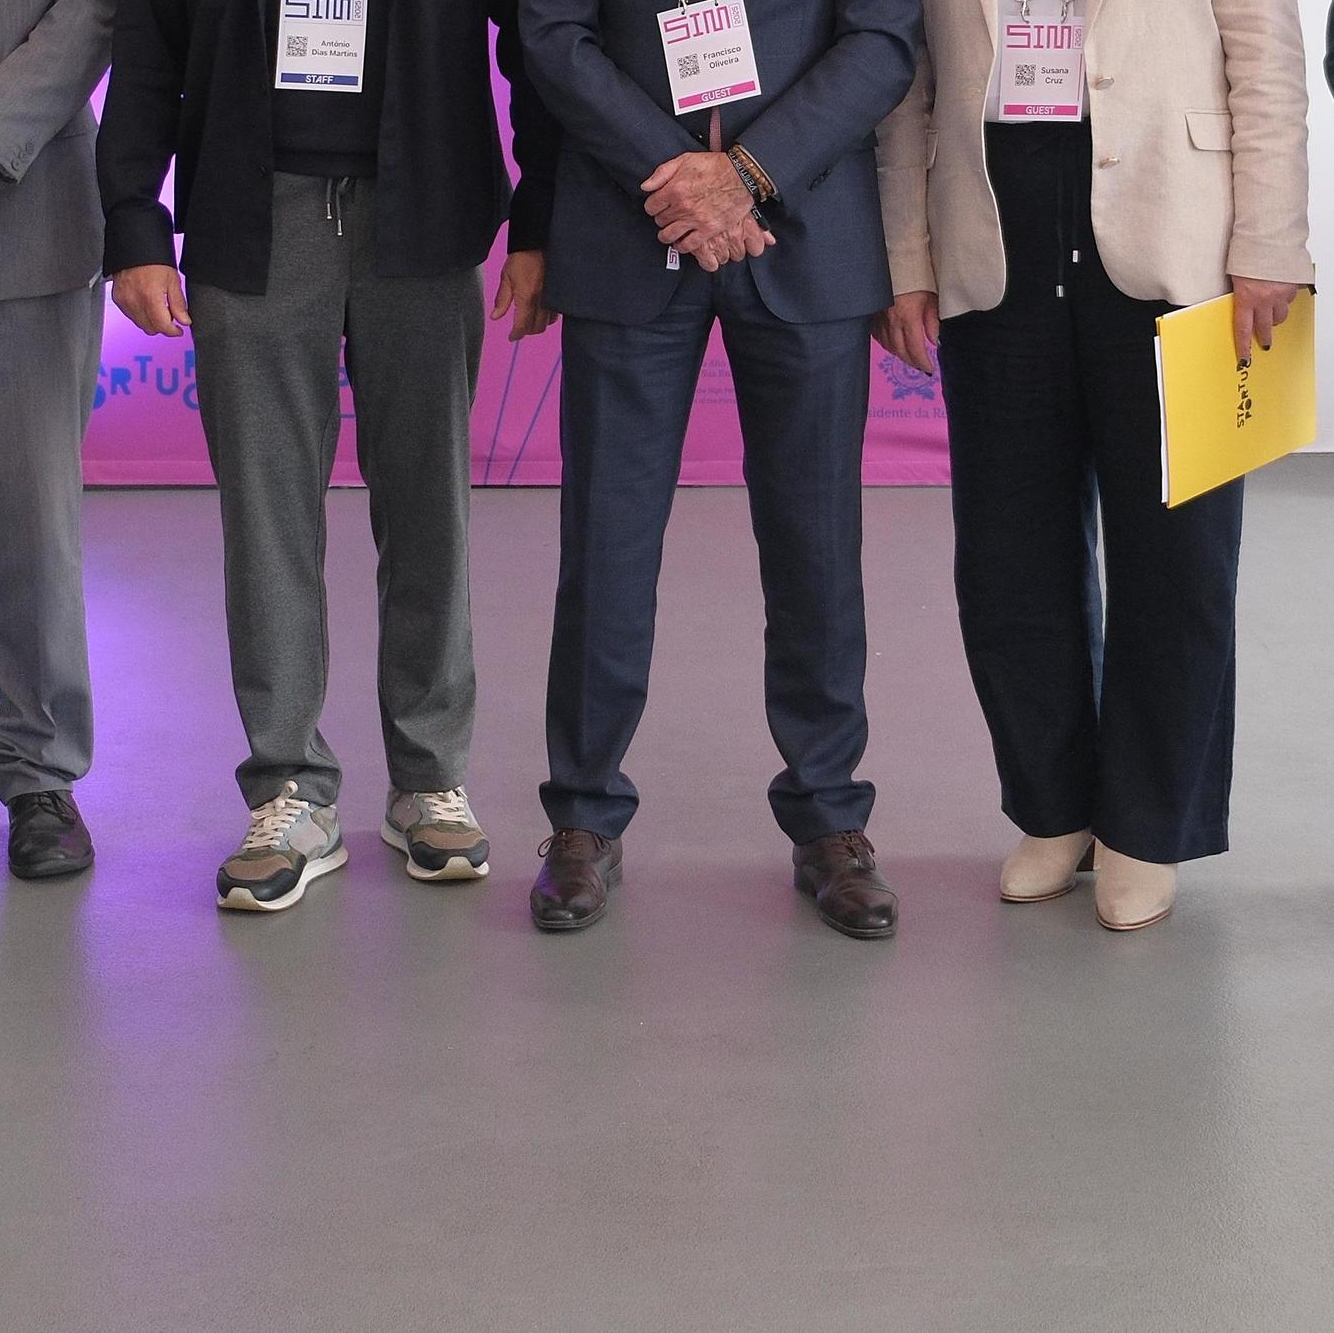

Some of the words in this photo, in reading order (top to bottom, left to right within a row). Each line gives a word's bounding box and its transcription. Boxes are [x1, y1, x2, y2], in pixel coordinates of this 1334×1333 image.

[663, 6, 731, 44] SIM
[1006, 25, 1072, 49] SIM
[321, 40, 350, 48] António
[703, 46, 742, 60] Francisco
[709, 57, 740, 69] Oliveira
[305, 75, 334, 84] STAFF
[701, 88, 732, 102] GUEST
[1026, 106, 1055, 114] GUEST
